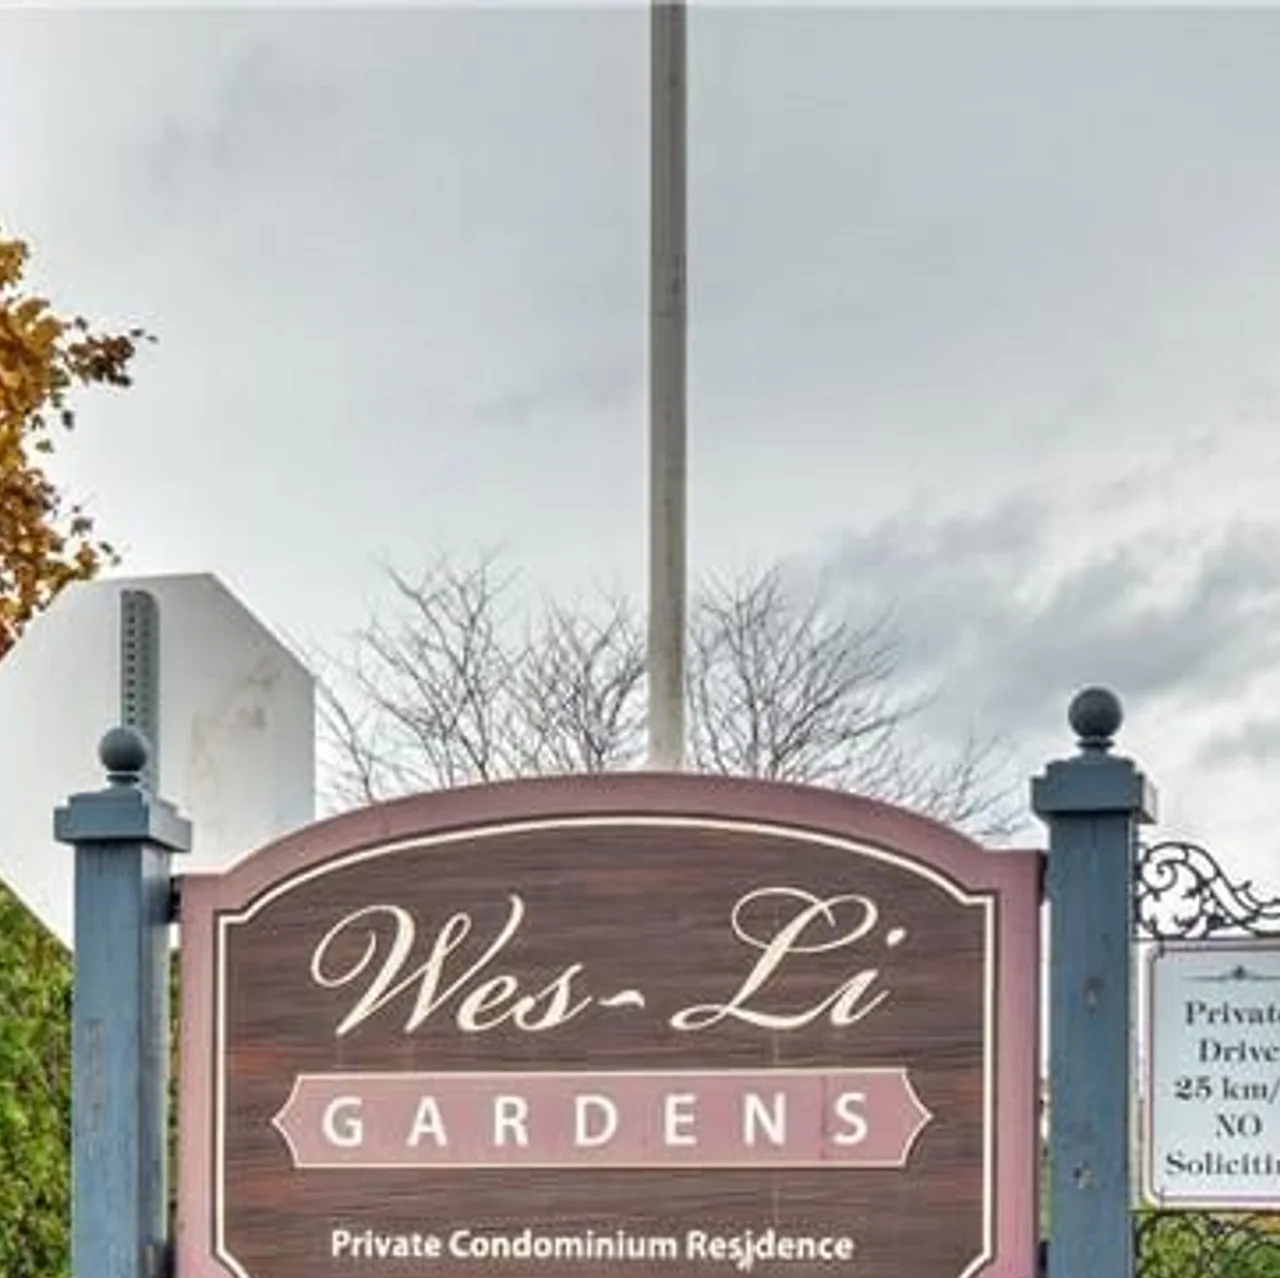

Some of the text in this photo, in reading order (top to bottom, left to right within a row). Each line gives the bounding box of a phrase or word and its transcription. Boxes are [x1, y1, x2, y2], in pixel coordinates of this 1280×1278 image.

[1175, 1075, 1213, 1101] 25
[322, 1091, 868, 1148] GARDENS
[1216, 1113, 1263, 1138] NO
[331, 1229, 442, 1259] Private
[448, 1229, 679, 1260] Condominium
